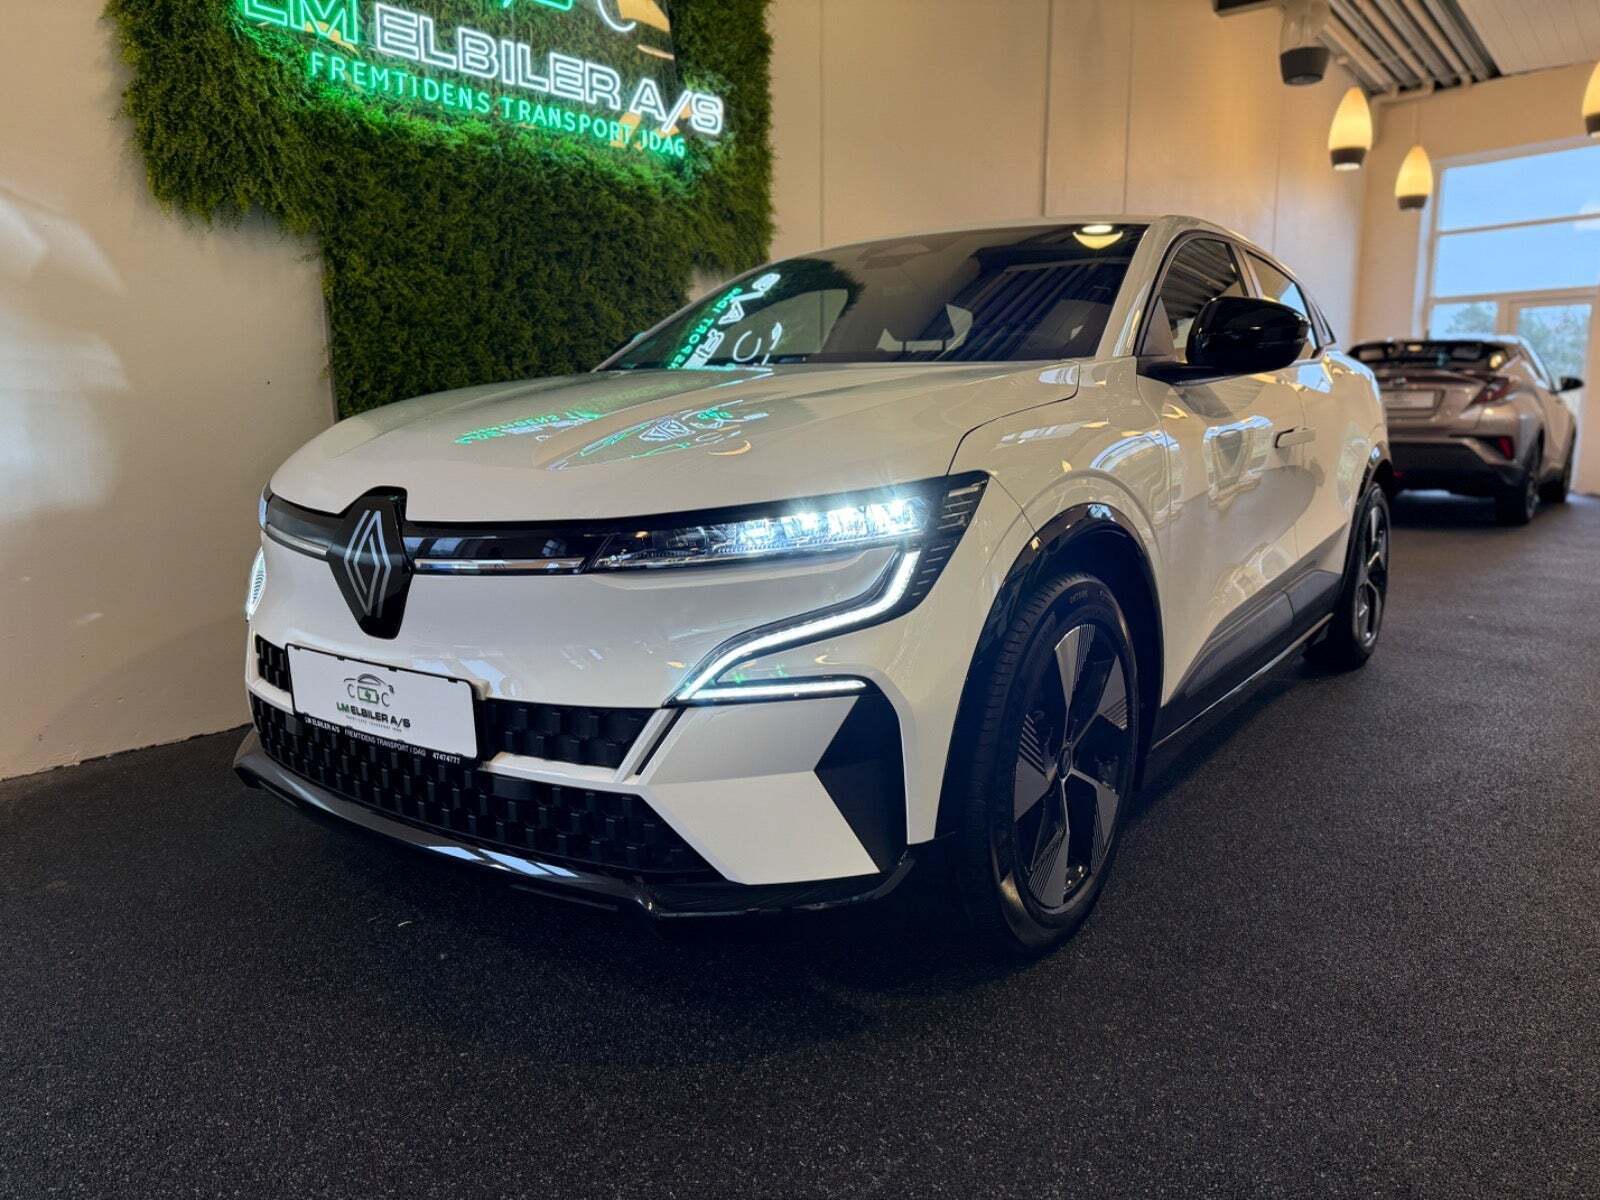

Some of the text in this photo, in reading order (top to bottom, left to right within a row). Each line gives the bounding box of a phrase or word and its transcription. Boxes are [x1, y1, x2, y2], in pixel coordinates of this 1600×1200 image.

[310, 51, 491, 114] FREMTIDENS
[499, 97, 633, 145] TRANSPORT
[374, 2, 622, 111] ELBILER
[628, 77, 724, 135] A/S
[336, 701, 350, 713] LM
[350, 705, 389, 722] ELBILER
[390, 715, 411, 729] A/S
